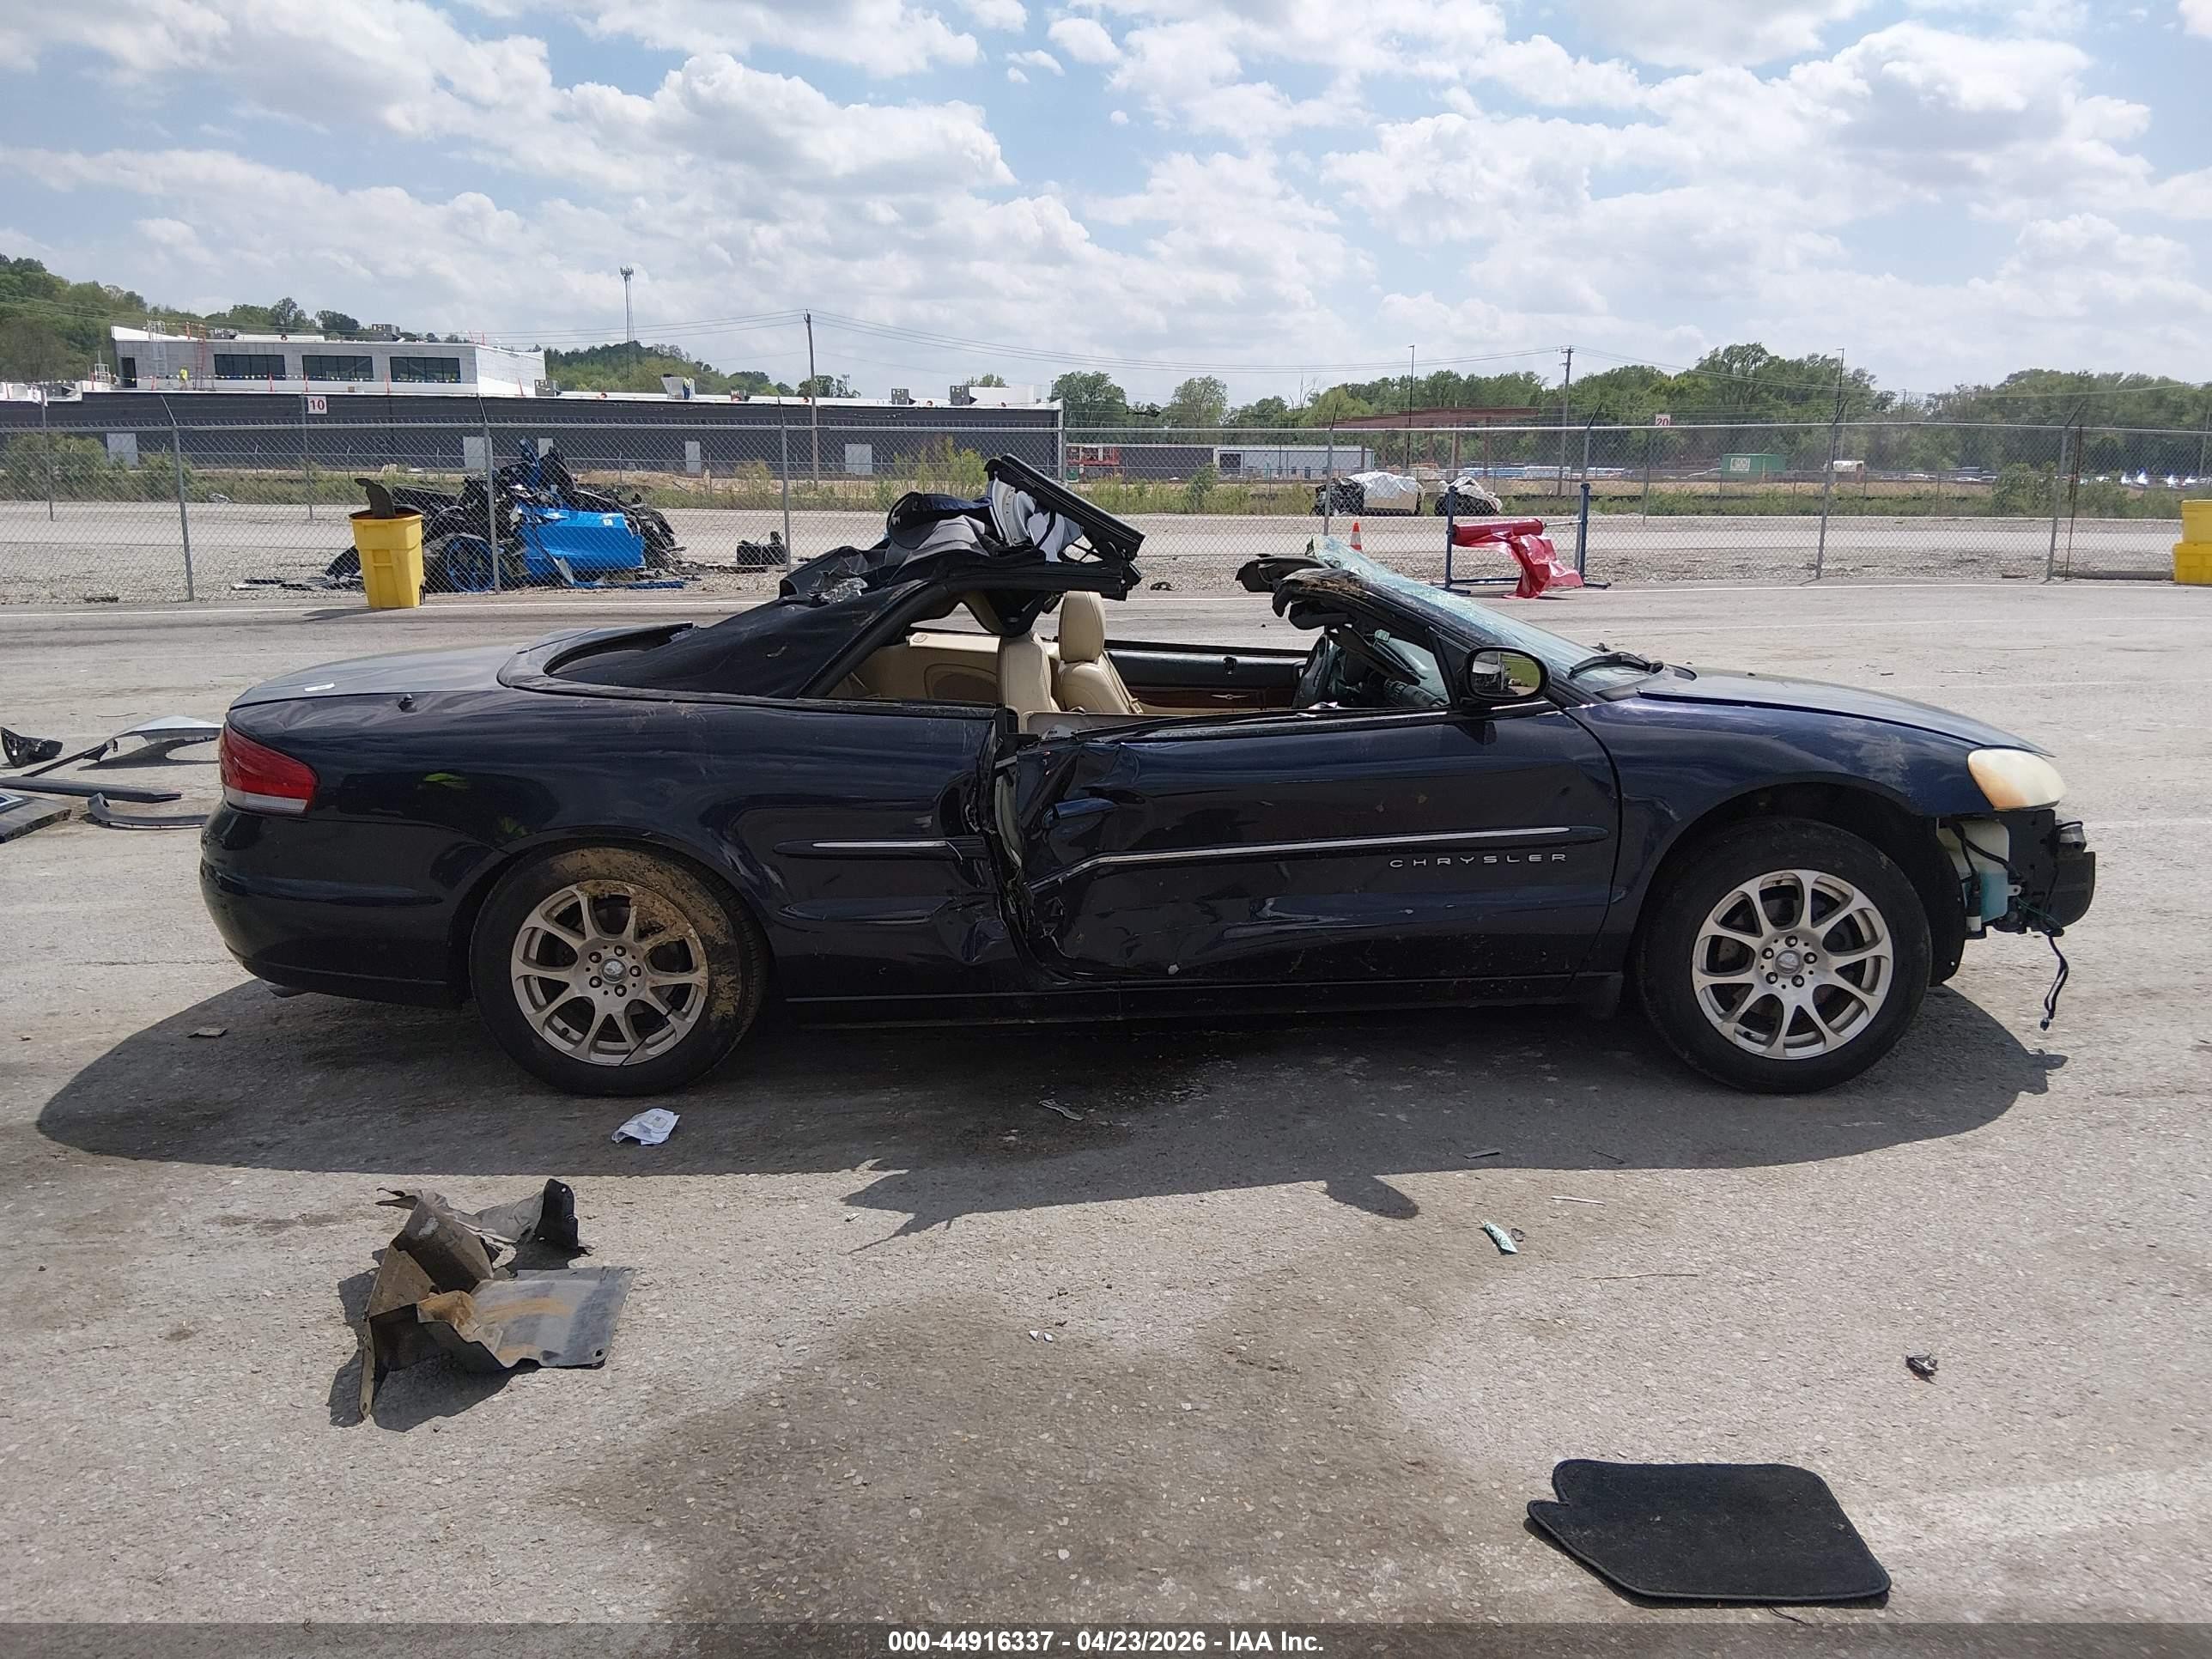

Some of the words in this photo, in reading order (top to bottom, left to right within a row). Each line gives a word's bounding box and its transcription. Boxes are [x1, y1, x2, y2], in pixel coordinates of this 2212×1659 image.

[310, 399, 325, 410] 10
[1656, 417, 1668, 426] 20
[1389, 854, 1566, 868] CHRYSLER
